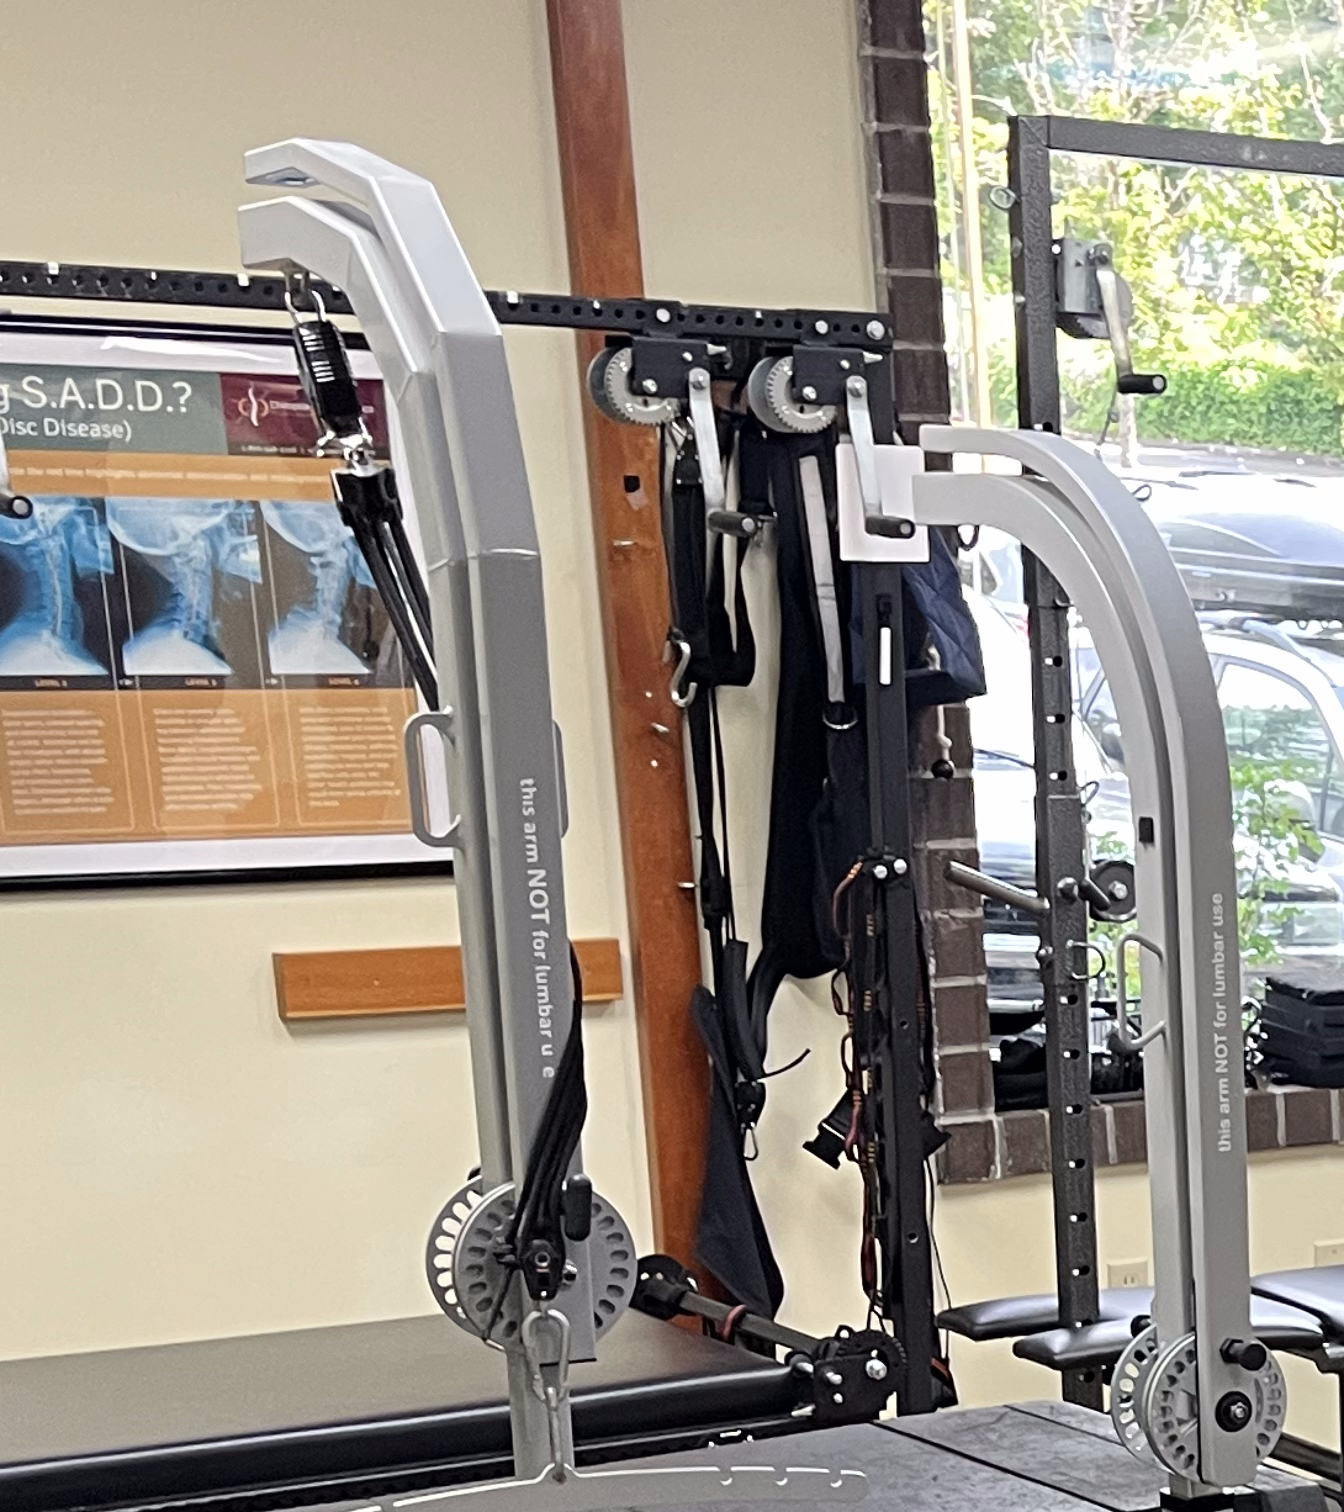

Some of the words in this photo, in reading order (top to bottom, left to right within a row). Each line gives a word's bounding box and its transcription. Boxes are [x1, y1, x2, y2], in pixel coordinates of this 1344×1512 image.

[22, 375, 192, 413] S.A.D.D.?
[43, 417, 132, 443] Disease)
[520, 777, 537, 817] this
[524, 822, 538, 863] arm
[527, 868, 551, 925] NOT
[1212, 892, 1224, 927] use
[532, 929, 549, 961] for
[1212, 930, 1227, 998] lumbar
[535, 964, 554, 1039] lumbar
[1213, 1001, 1228, 1028] for
[1213, 1032, 1229, 1074] NOT
[1218, 1077, 1231, 1115] arm
[1217, 1118, 1232, 1152] this
